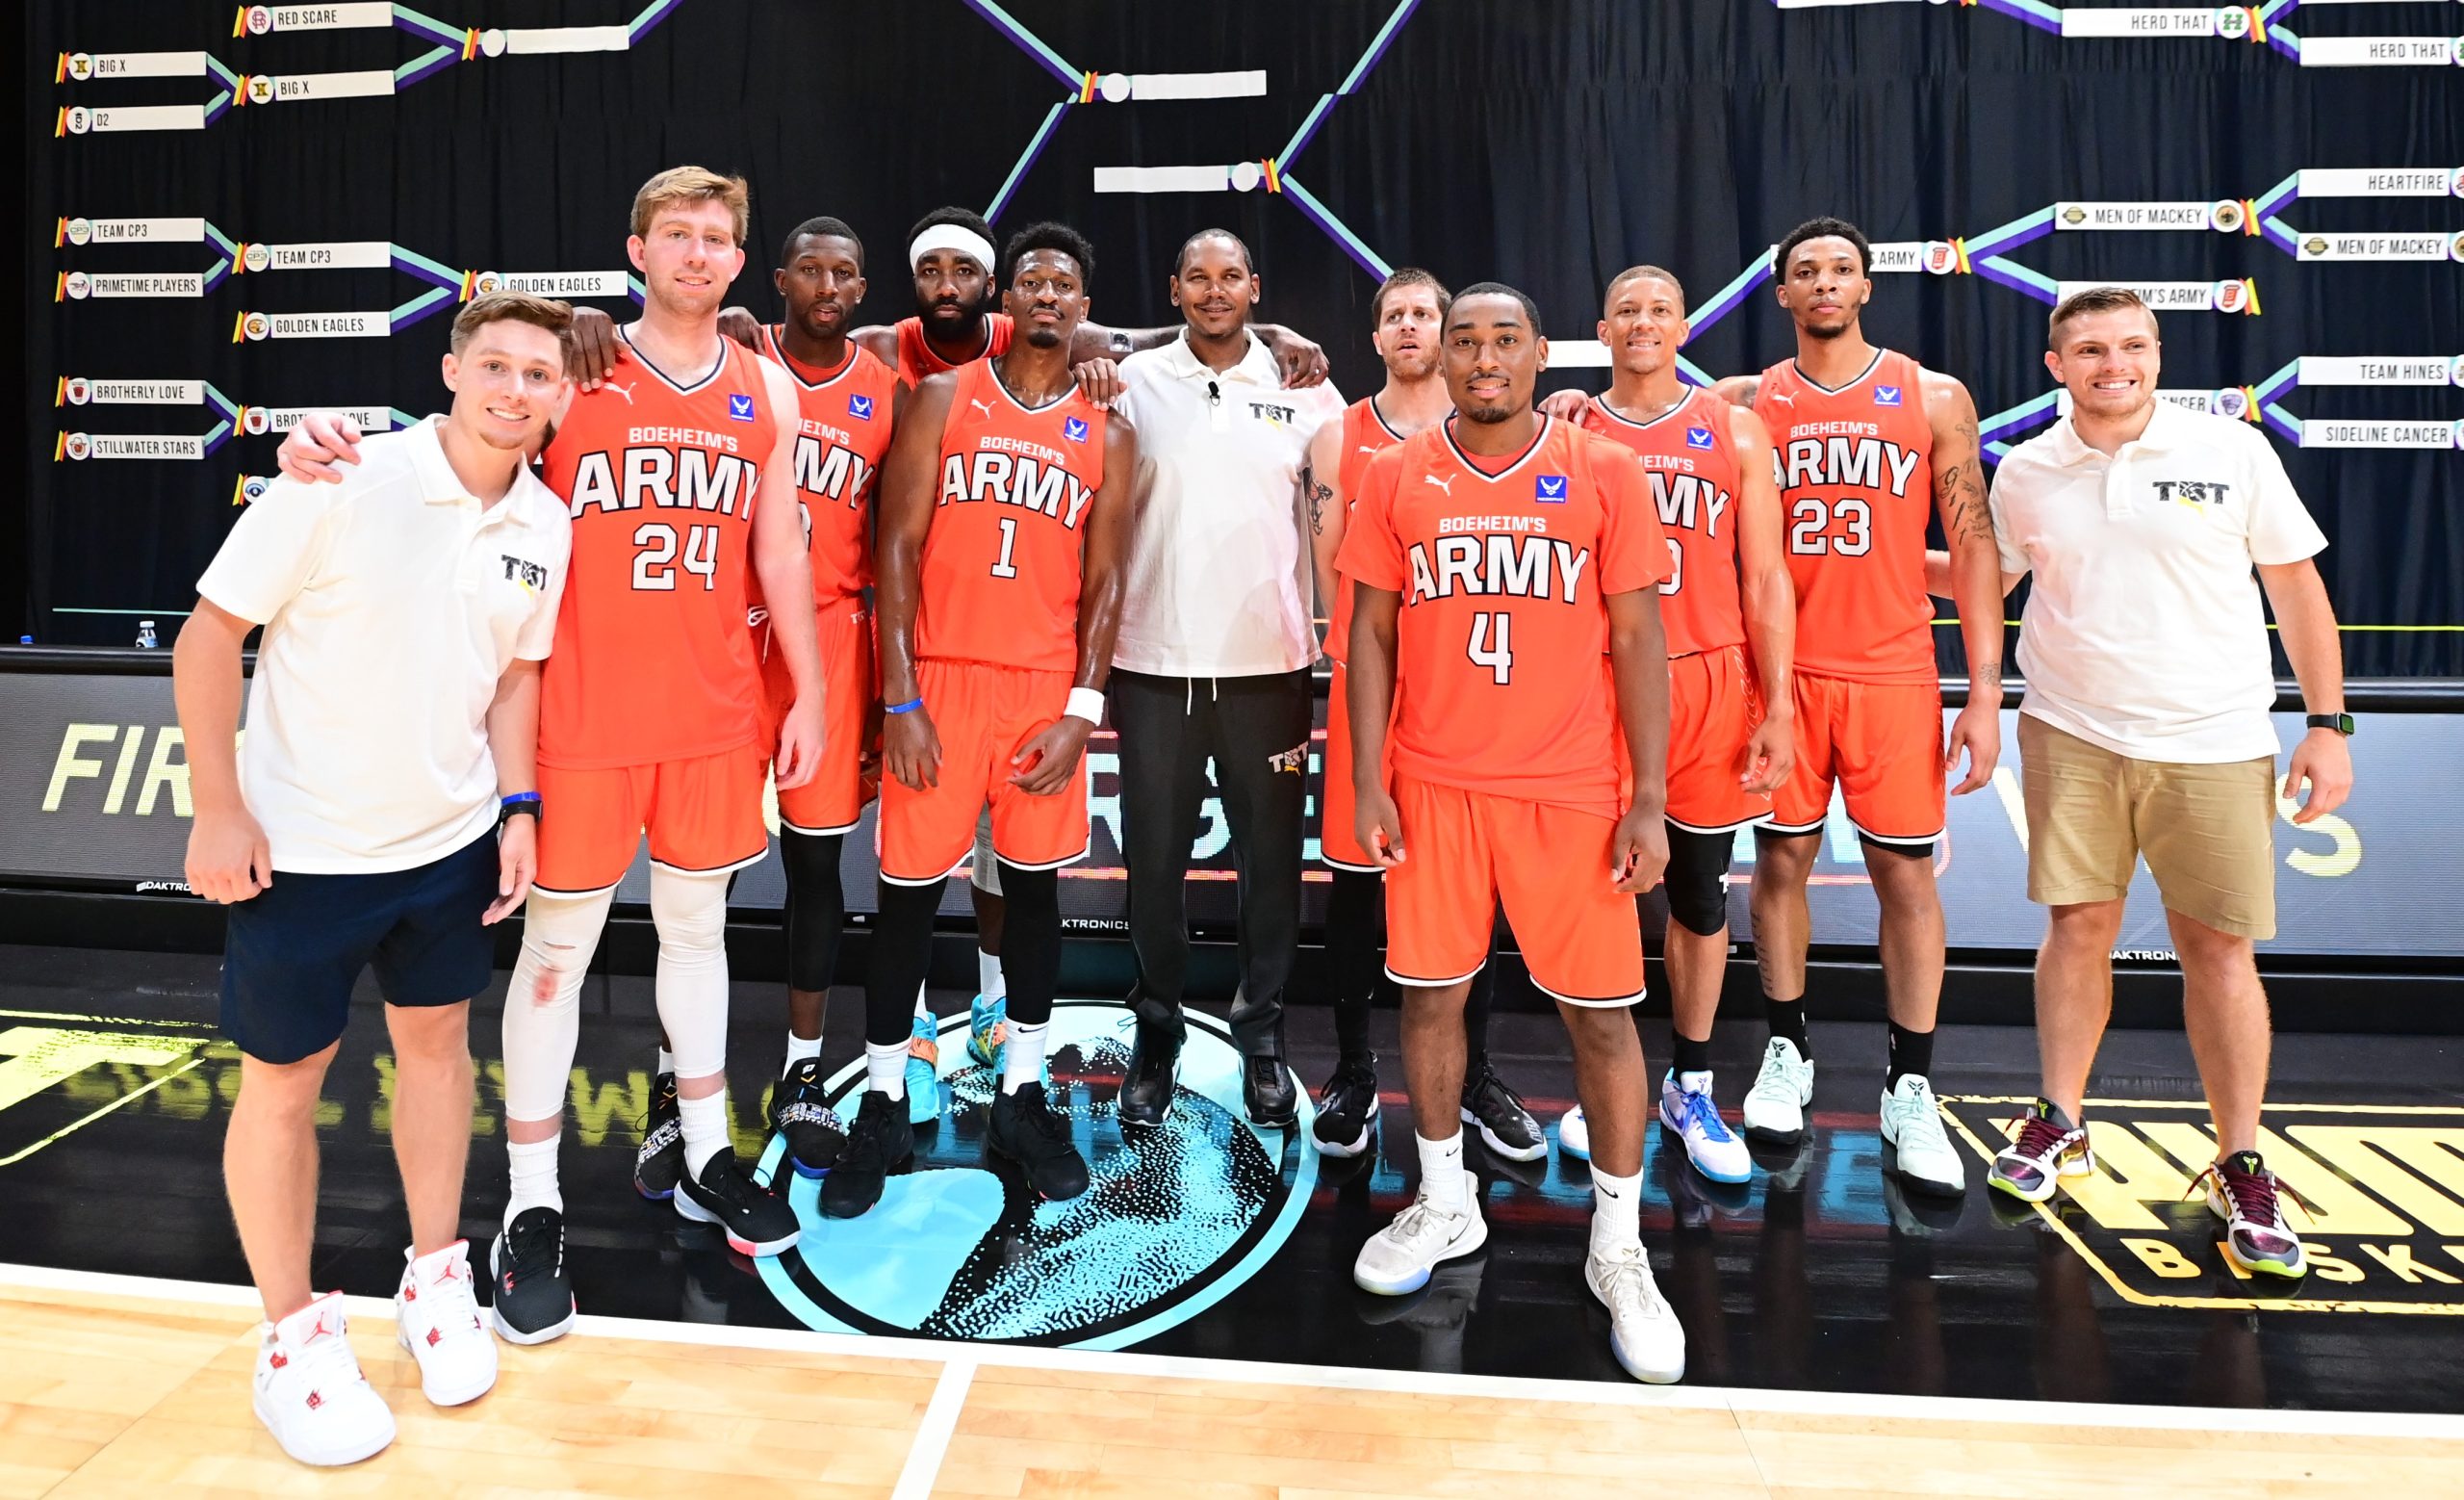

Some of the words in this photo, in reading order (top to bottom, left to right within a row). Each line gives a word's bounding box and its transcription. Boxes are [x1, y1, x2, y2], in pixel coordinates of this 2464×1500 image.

[277, 11, 298, 26] RED
[302, 10, 338, 25] SCARE
[2131, 14, 2168, 30] HERD
[2173, 14, 2208, 30] THAT
[2370, 43, 2406, 59] HERD
[2411, 43, 2445, 59] THAT
[99, 60, 116, 73] BIG
[119, 59, 126, 72] X
[280, 81, 298, 95] BIG
[302, 80, 310, 94] X
[96, 113, 109, 126] D2
[2368, 174, 2445, 191] HEARTFIRE
[2095, 208, 2123, 224] MEN
[2127, 208, 2144, 224] OF
[2148, 208, 2202, 224] MACKEY
[97, 224, 124, 238] TEAM
[128, 223, 147, 238] CP3
[2337, 239, 2365, 255] MEN
[2369, 239, 2386, 255] OF
[2389, 239, 2442, 255] MACKEY
[276, 250, 306, 265] TEAM
[310, 249, 331, 264] CP3
[1879, 250, 1915, 266] ARMY
[95, 279, 150, 293] PRIMETIME
[153, 278, 197, 293] PLAYERS
[509, 277, 555, 293] GOLDEN
[558, 276, 602, 292] EAGLES
[2169, 288, 2207, 303] ARMY
[275, 319, 320, 333] GOLDEN
[322, 318, 365, 332] EAGLES
[2360, 364, 2399, 379] TEAM
[2403, 364, 2444, 380] HINES
[96, 385, 155, 399] BROTHERLY
[159, 385, 185, 399] LOVE
[1790, 421, 1879, 438] BOEHEIM'S
[2325, 427, 2390, 443] SIDELINE
[2394, 427, 2448, 443] CANCER
[96, 440, 160, 454] STILLWATER
[163, 441, 196, 455] STARS
[629, 427, 738, 453] BOEHEIM'S
[980, 436, 1065, 465] BOEHEIM'S
[570, 446, 763, 521] ARMY
[939, 452, 1094, 530] ARMY
[1439, 516, 1547, 534] BOEHEIM'S
[1790, 498, 1872, 556] 23
[630, 522, 719, 591] 24
[990, 517, 1018, 580] 1
[1408, 534, 1590, 608] ARMY
[1466, 611, 1513, 685] 4
[41, 722, 195, 817] FIR
[145, 881, 192, 892] DAKTRO
